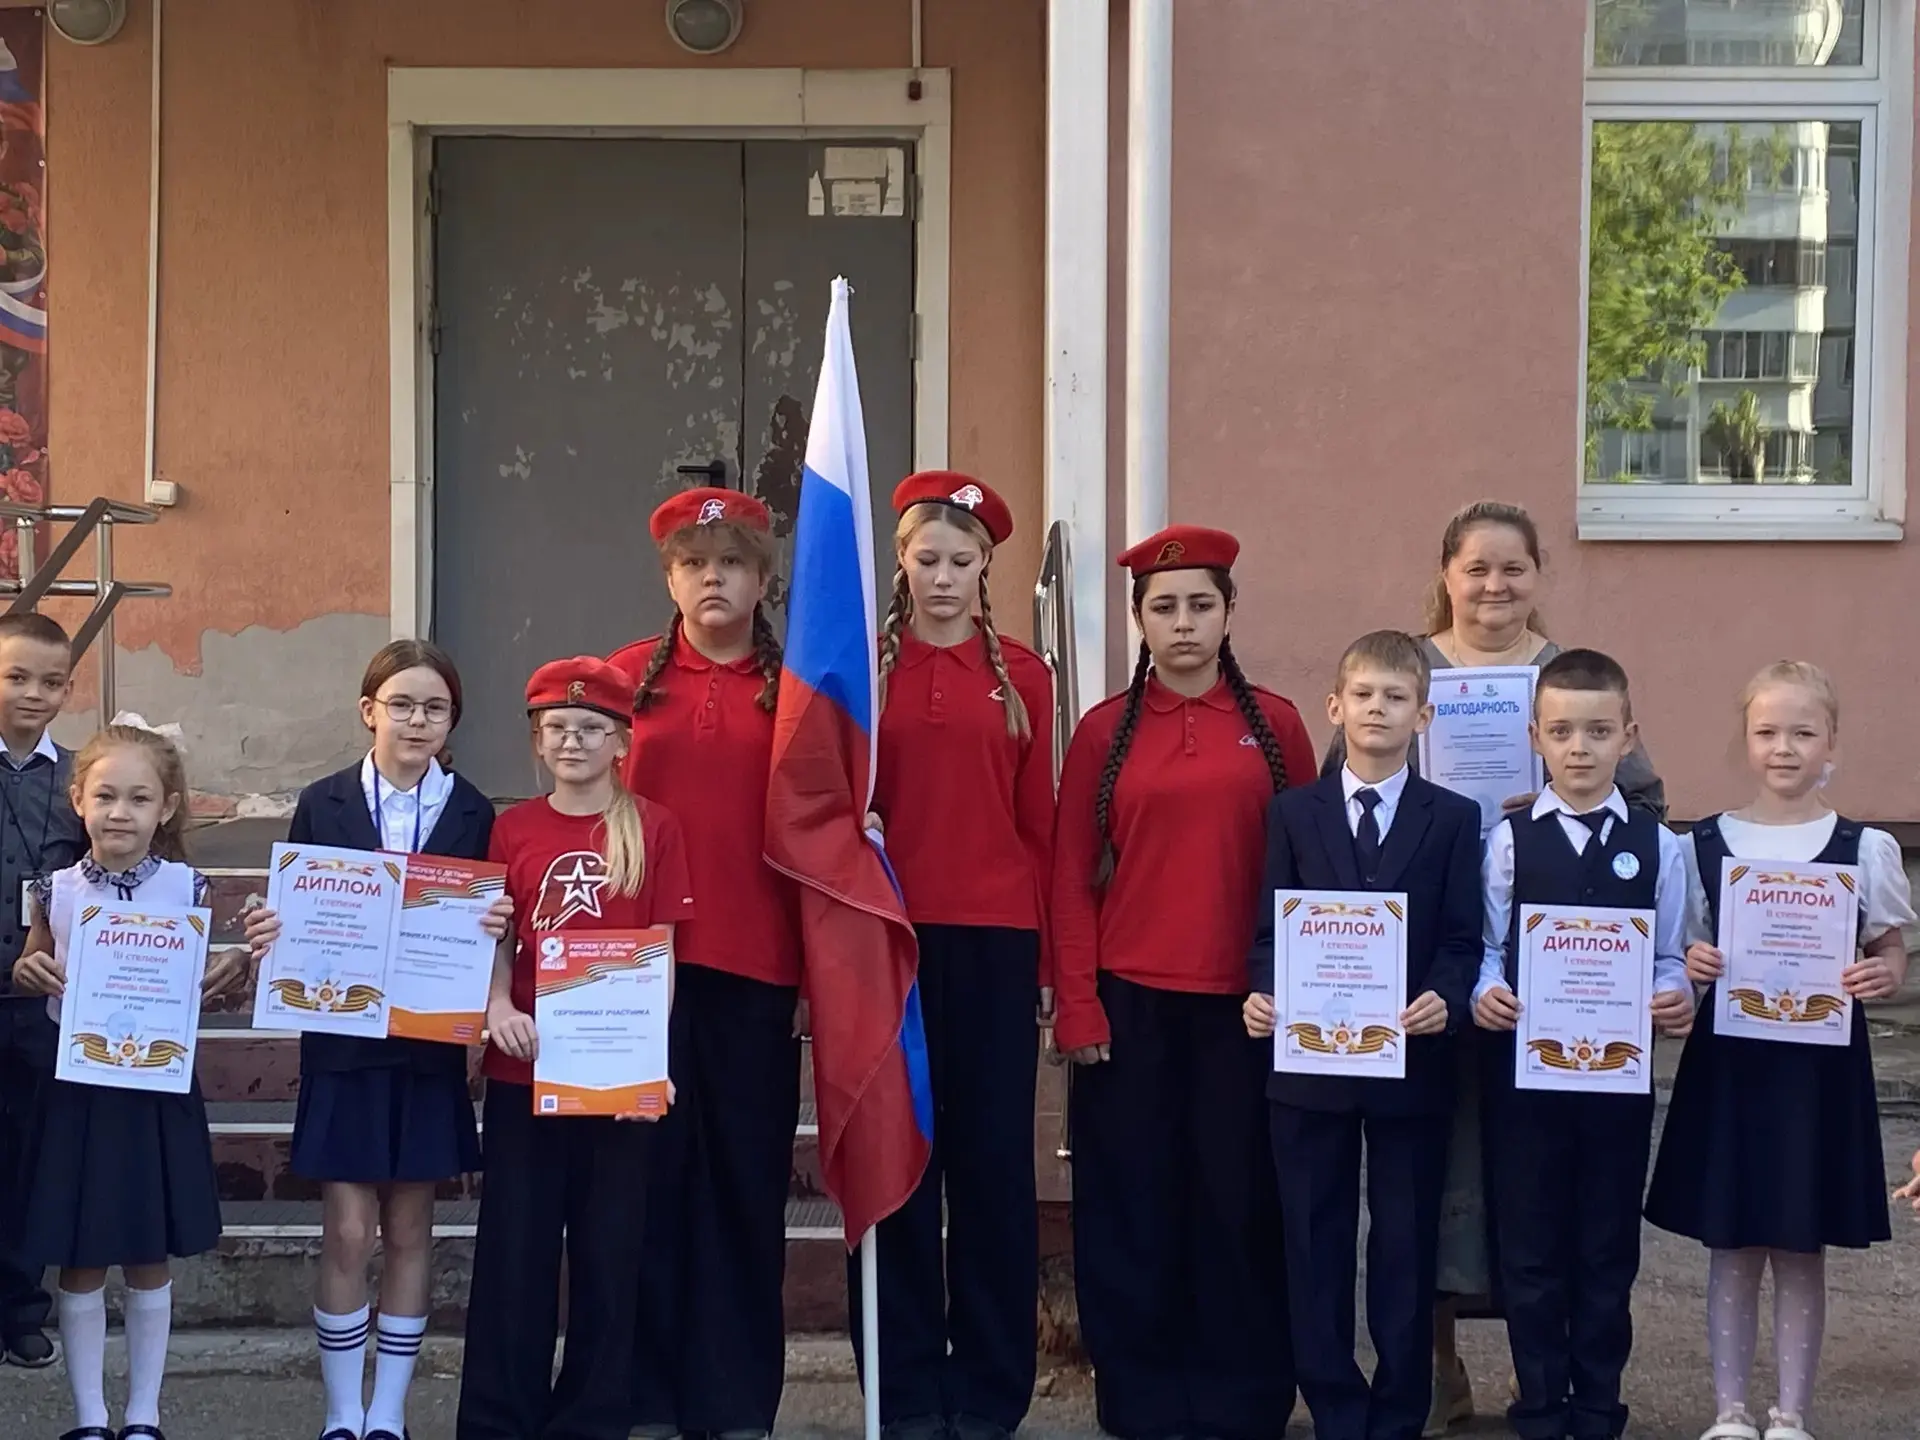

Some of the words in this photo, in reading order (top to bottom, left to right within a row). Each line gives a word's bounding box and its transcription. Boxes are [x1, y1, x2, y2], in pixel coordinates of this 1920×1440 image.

[1437, 701, 1520, 716] БЛАГОДАРНОСТЬ
[293, 876, 381, 897] ДИПЛОМ
[1745, 889, 1836, 908] ДИПЛОМ
[1299, 920, 1385, 937] ДИПЛОМ
[96, 930, 185, 950] ДИПЛОМ
[1543, 936, 1630, 953] ДИПЛОМ
